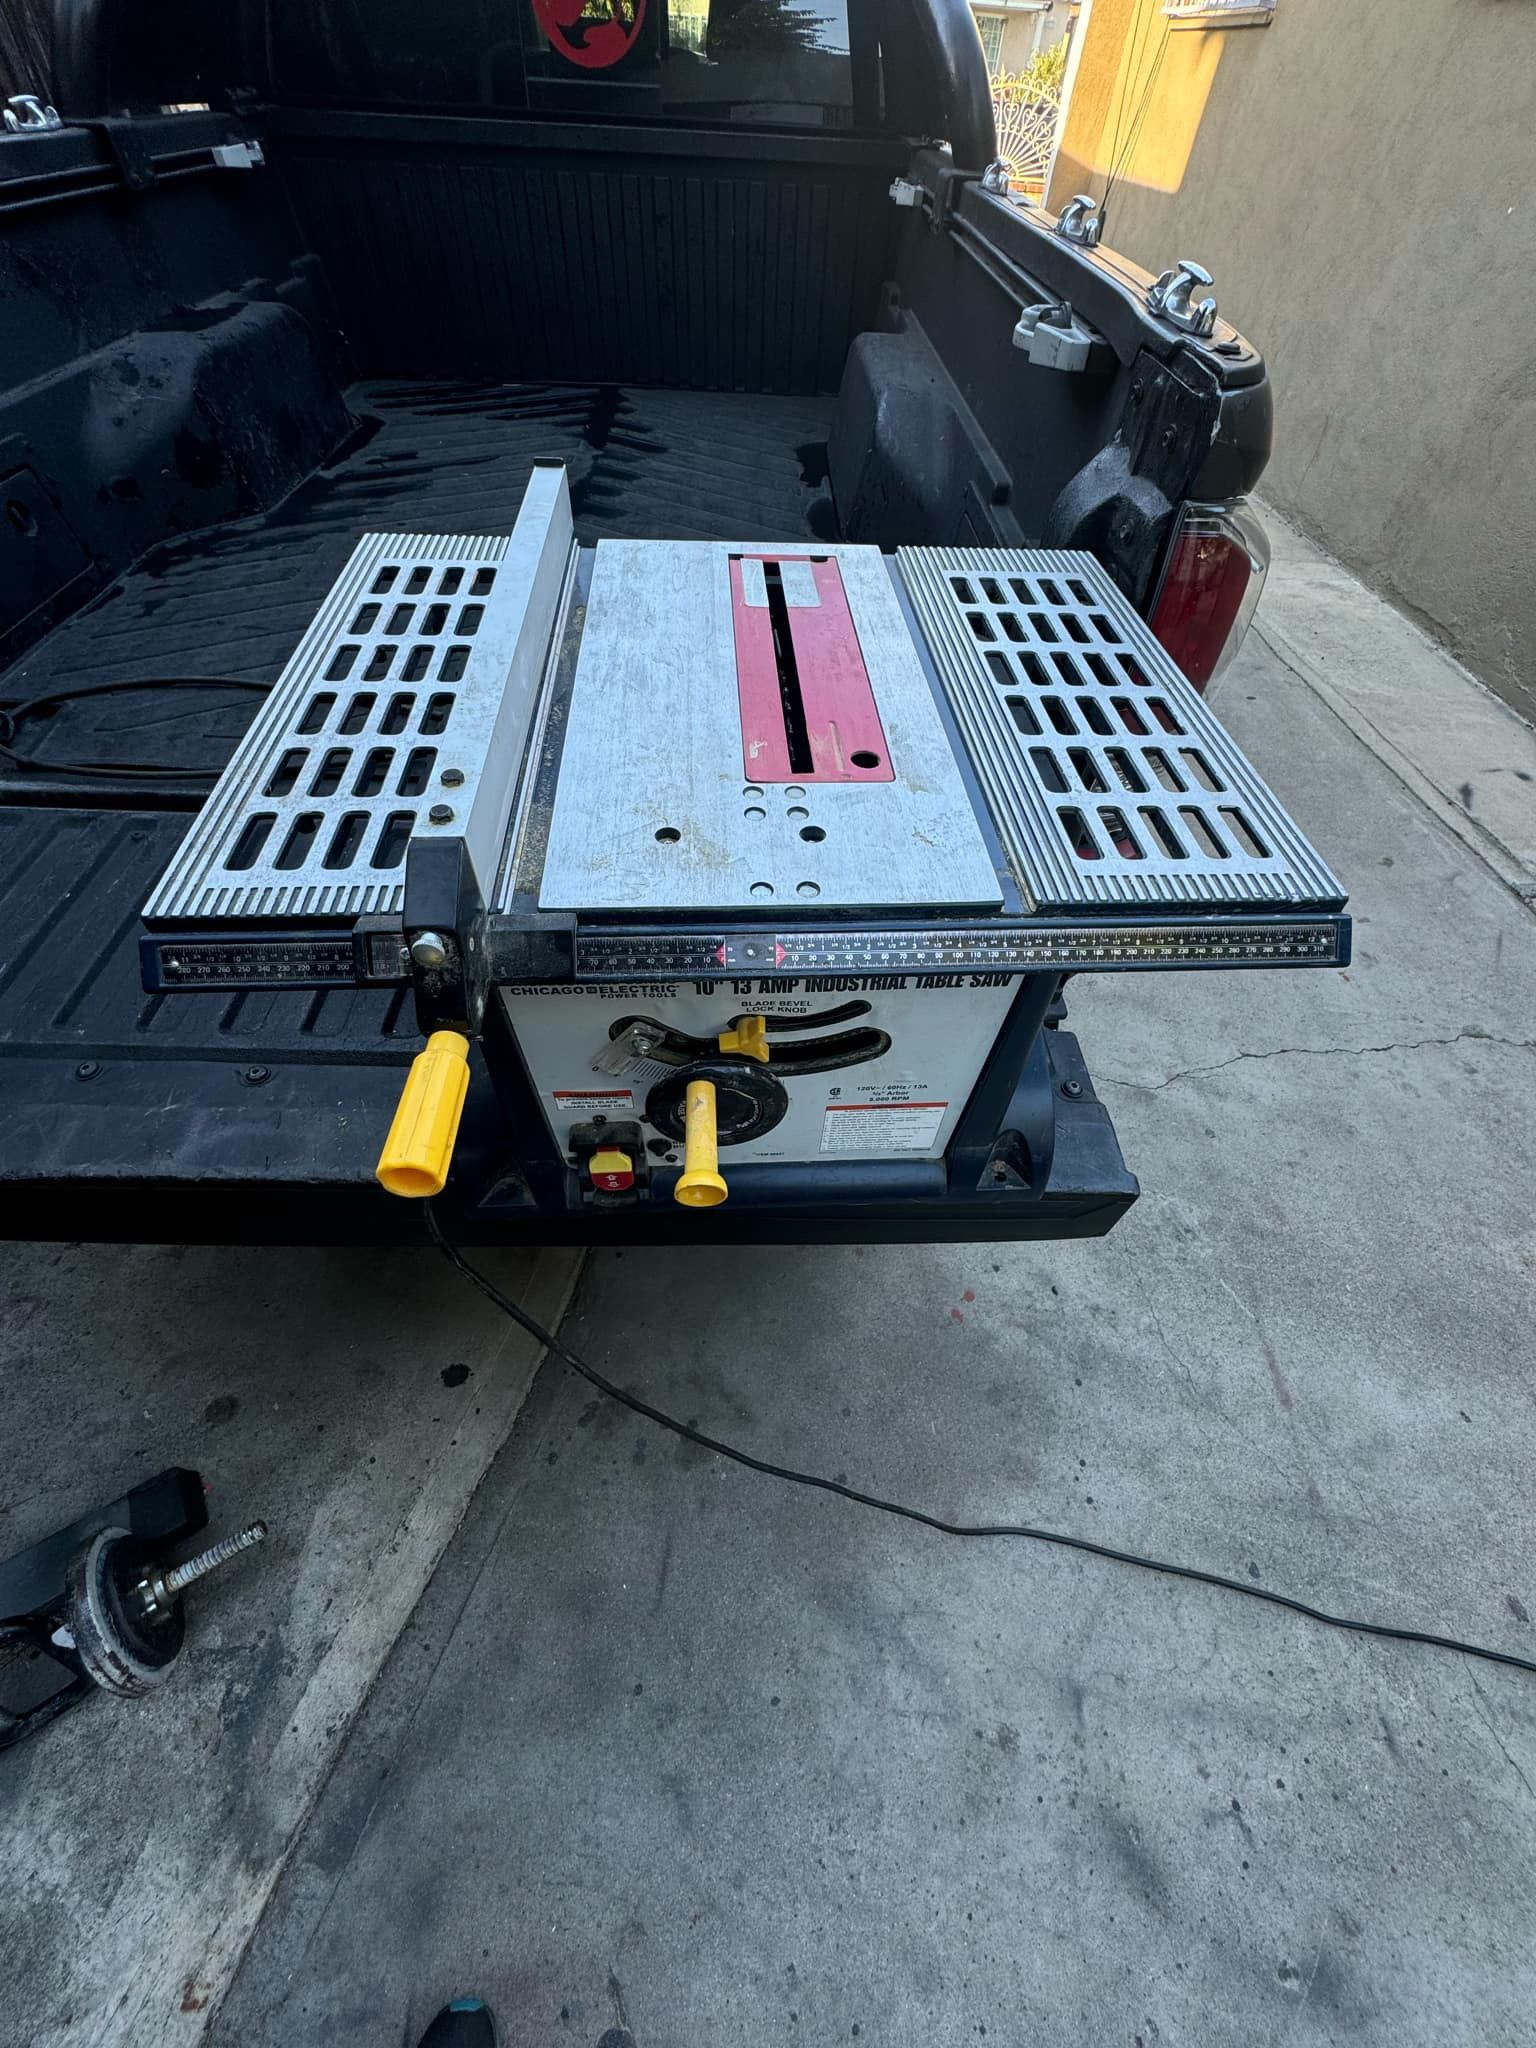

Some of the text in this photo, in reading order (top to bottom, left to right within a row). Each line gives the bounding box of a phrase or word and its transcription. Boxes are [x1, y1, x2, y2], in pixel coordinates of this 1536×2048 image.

[511, 984, 677, 996] CHICAGO ELECTRIC
[731, 978, 752, 995] 13
[758, 977, 799, 994] AMP
[805, 975, 907, 993] INDUSTRIAL
[916, 974, 964, 989] TABLE
[970, 973, 1014, 988] SAW
